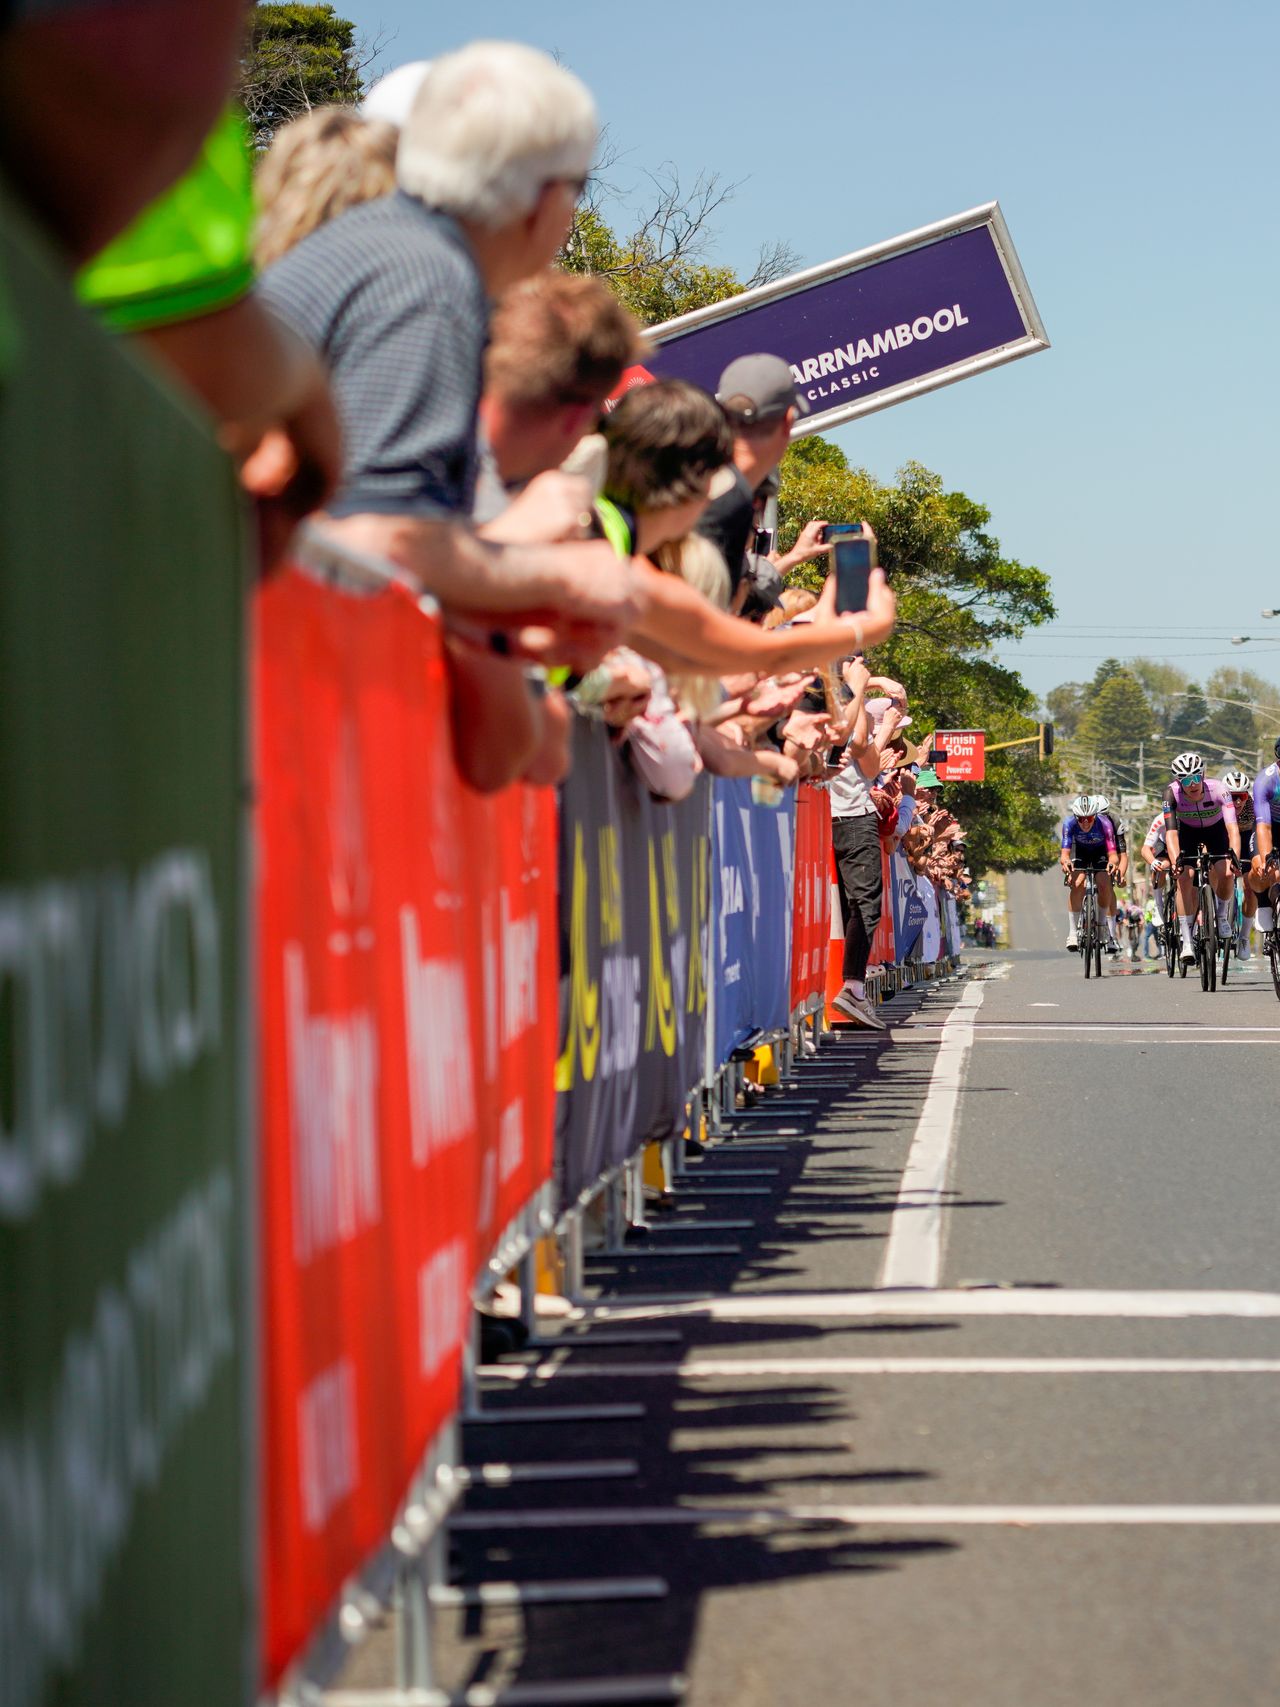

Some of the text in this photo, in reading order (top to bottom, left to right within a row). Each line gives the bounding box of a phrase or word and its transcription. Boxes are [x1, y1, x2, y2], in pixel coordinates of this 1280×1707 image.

[789, 304, 969, 384] ARRNAMBOOL
[807, 366, 880, 401] CLASSIC
[942, 734, 976, 745] Finish
[946, 745, 973, 756] 50m
